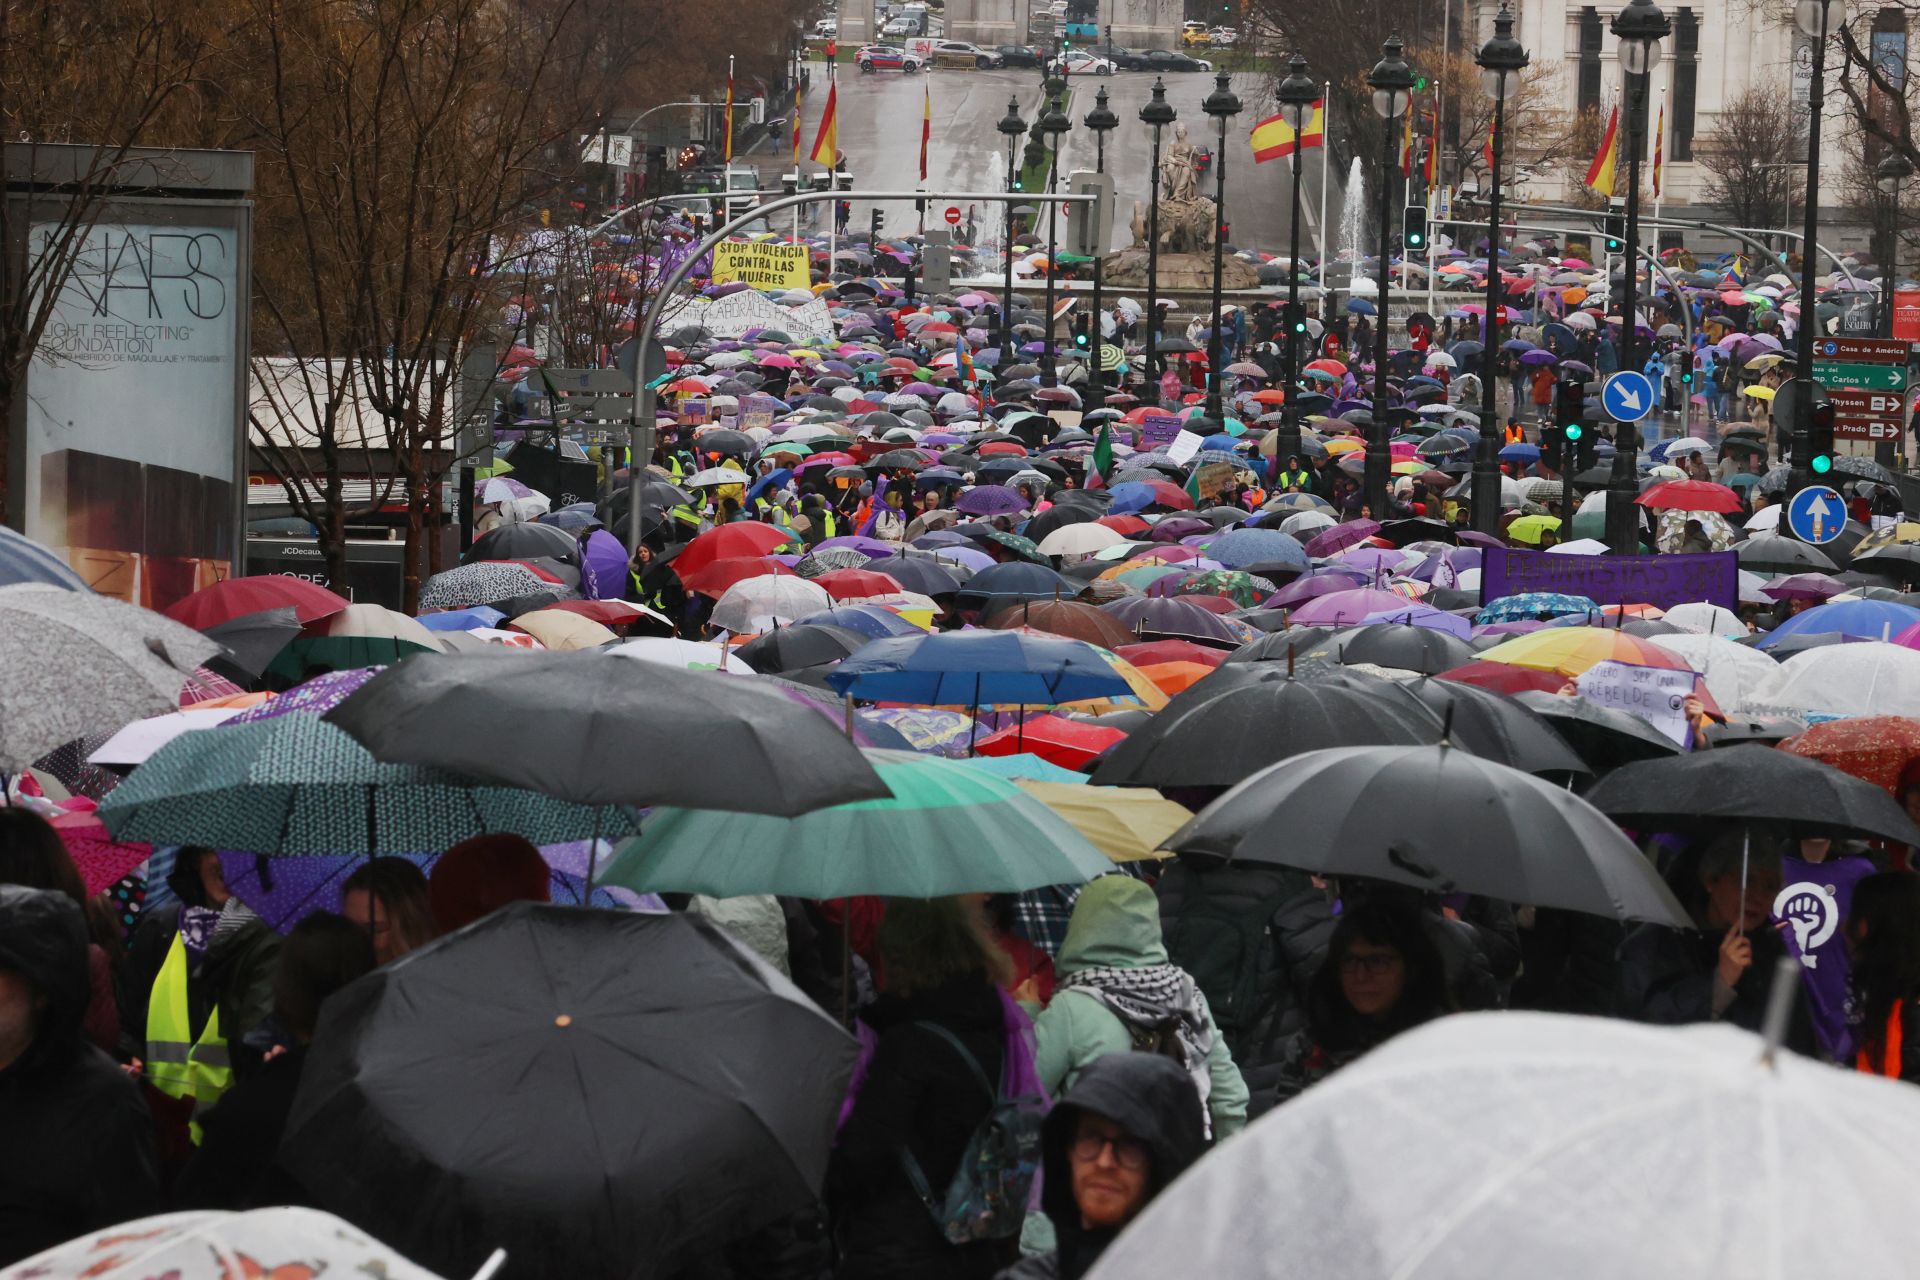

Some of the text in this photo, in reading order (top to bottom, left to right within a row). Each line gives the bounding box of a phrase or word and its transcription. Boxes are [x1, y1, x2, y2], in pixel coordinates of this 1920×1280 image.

[720, 242, 748, 254] STOP
[752, 243, 804, 259] VIOLENCIA
[729, 256, 795, 273] CONTRA LAS
[43, 230, 226, 319] NARS
[737, 270, 785, 286] MUJERES
[42, 323, 190, 341] LIGHT REFLECTING
[42, 337, 153, 354] FOUNDATION
[1840, 345, 1905, 355] Casa de América
[113, 353, 126, 362] DE
[127, 354, 178, 363] MAQUILLAJE
[1832, 375, 1860, 385] Carlos
[1864, 376, 1870, 385] V
[1830, 398, 1865, 408] Thyssen
[1842, 424, 1866, 433] Prado
[281, 547, 322, 556] JCDecaux
[1505, 552, 1668, 585] FEMINISTAS
[1588, 682, 1651, 708] REBELDE
